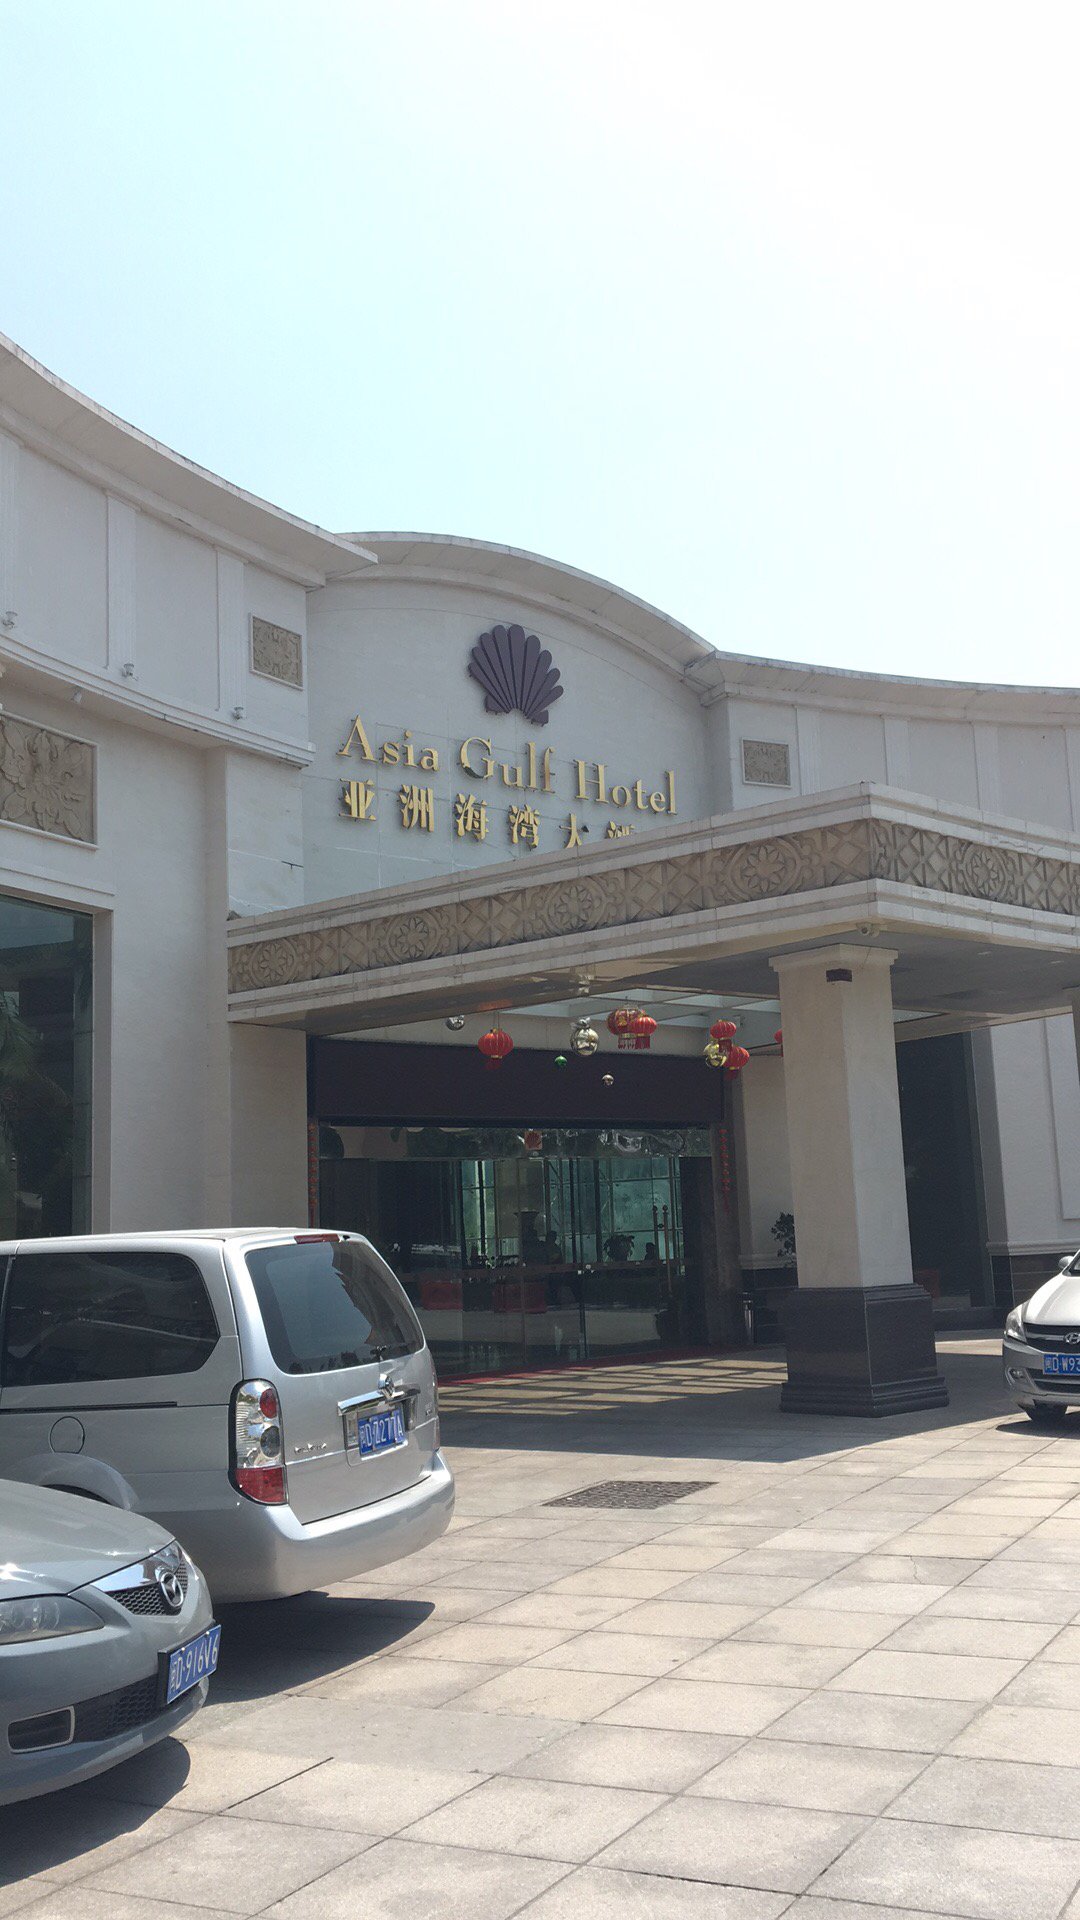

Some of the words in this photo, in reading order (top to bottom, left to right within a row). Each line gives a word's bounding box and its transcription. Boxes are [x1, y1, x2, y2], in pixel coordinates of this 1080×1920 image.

[336, 714, 440, 772] Asia
[458, 736, 556, 795] Gulf
[572, 758, 678, 816] Hotel
